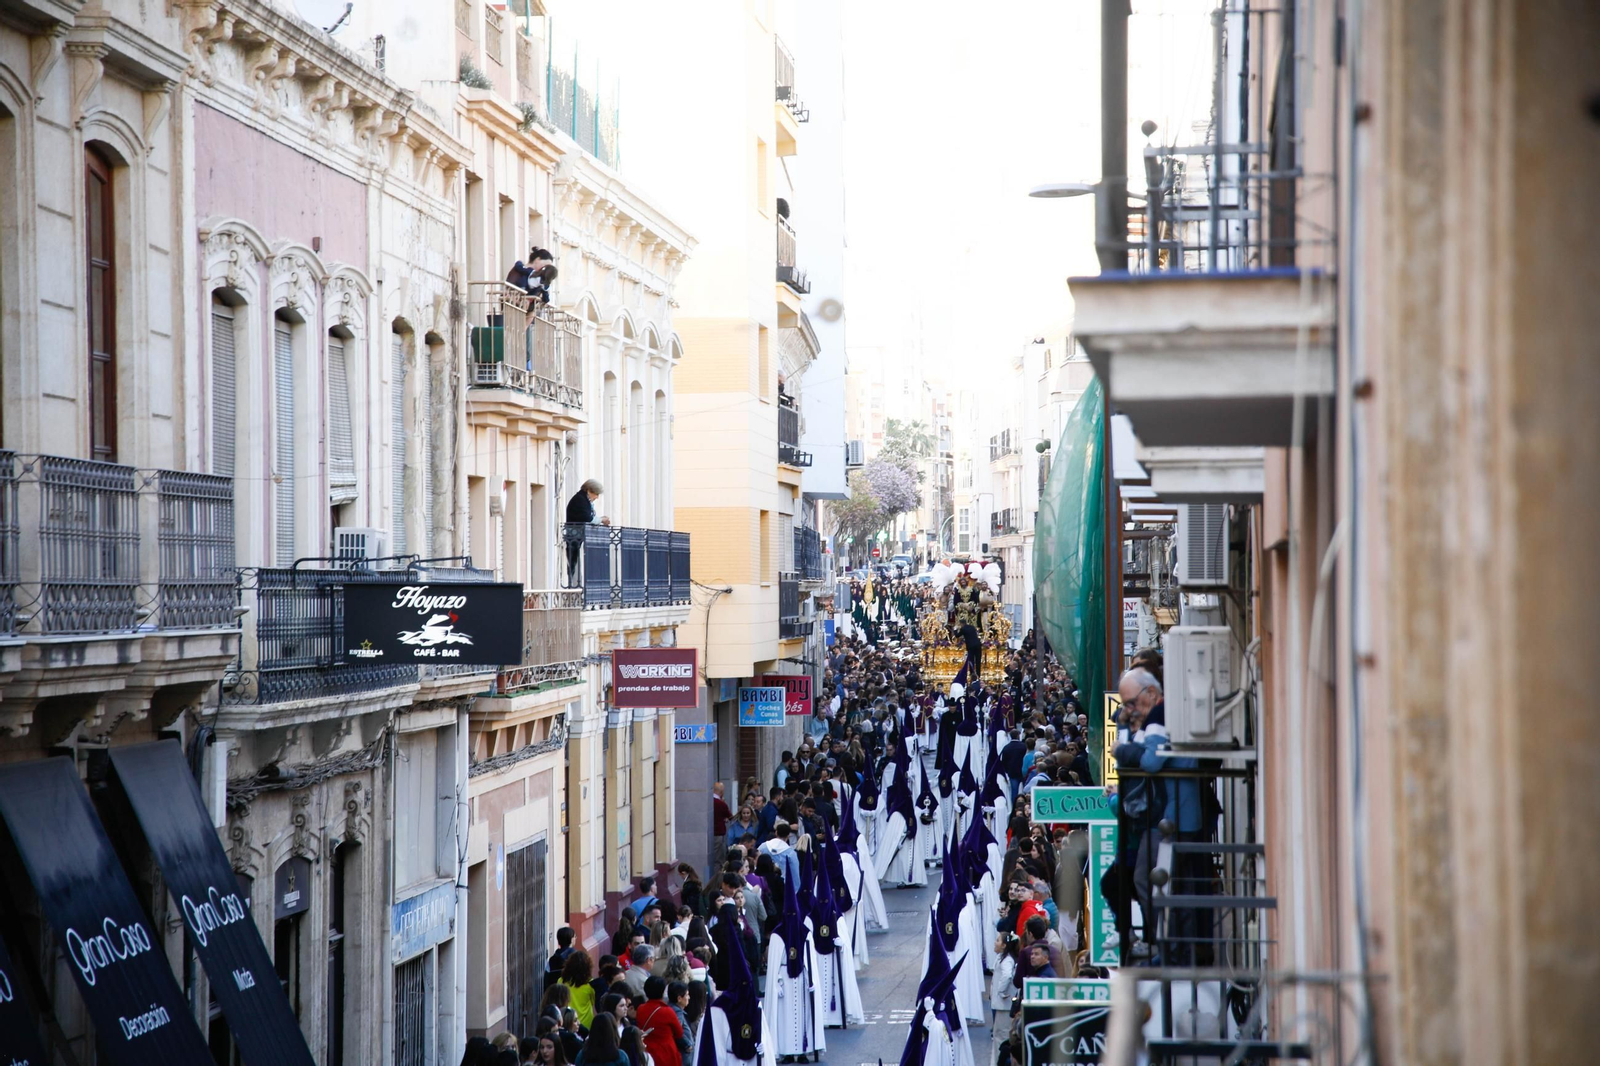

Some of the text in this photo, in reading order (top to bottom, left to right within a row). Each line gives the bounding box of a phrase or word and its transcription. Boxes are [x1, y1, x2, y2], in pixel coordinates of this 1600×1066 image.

[391, 585, 467, 615] Hoyazo
[413, 647, 436, 657] CAFÉ
[441, 649, 460, 657] BAR
[618, 664, 693, 679] WORKING
[617, 685, 650, 693] prendas
[741, 689, 783, 702] BAMBI
[785, 701, 803, 713] bés
[1100, 827, 1119, 961] FERERA
[1028, 984, 1109, 1001] ELECTR
[118, 1002, 171, 1041] Decoración
[1059, 1032, 1109, 1056] CAÑ
